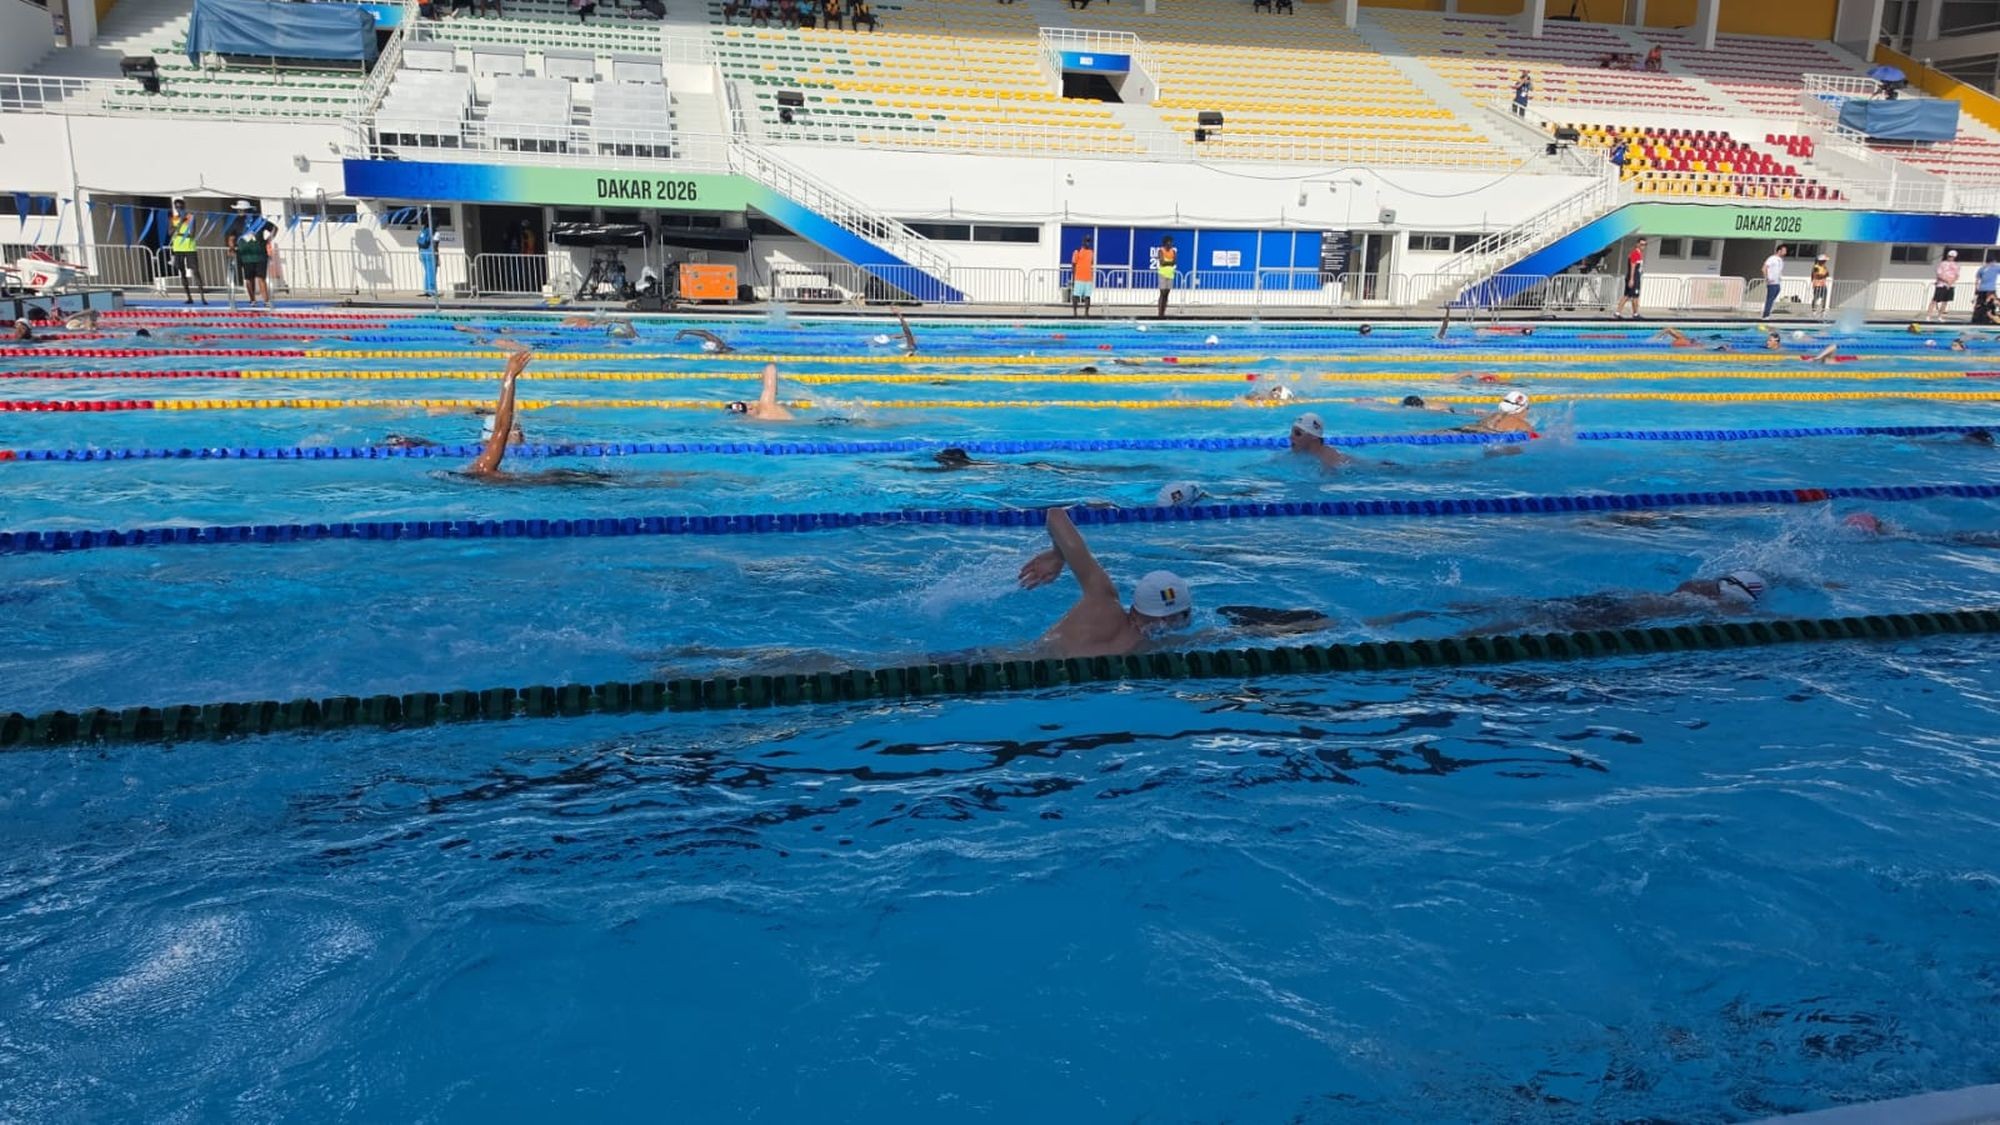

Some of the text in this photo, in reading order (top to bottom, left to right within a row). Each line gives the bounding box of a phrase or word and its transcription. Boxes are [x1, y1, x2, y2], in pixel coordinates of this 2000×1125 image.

[597, 178, 697, 201] DAKAR 2026
[1735, 214, 1802, 233] DAKAR 2026
